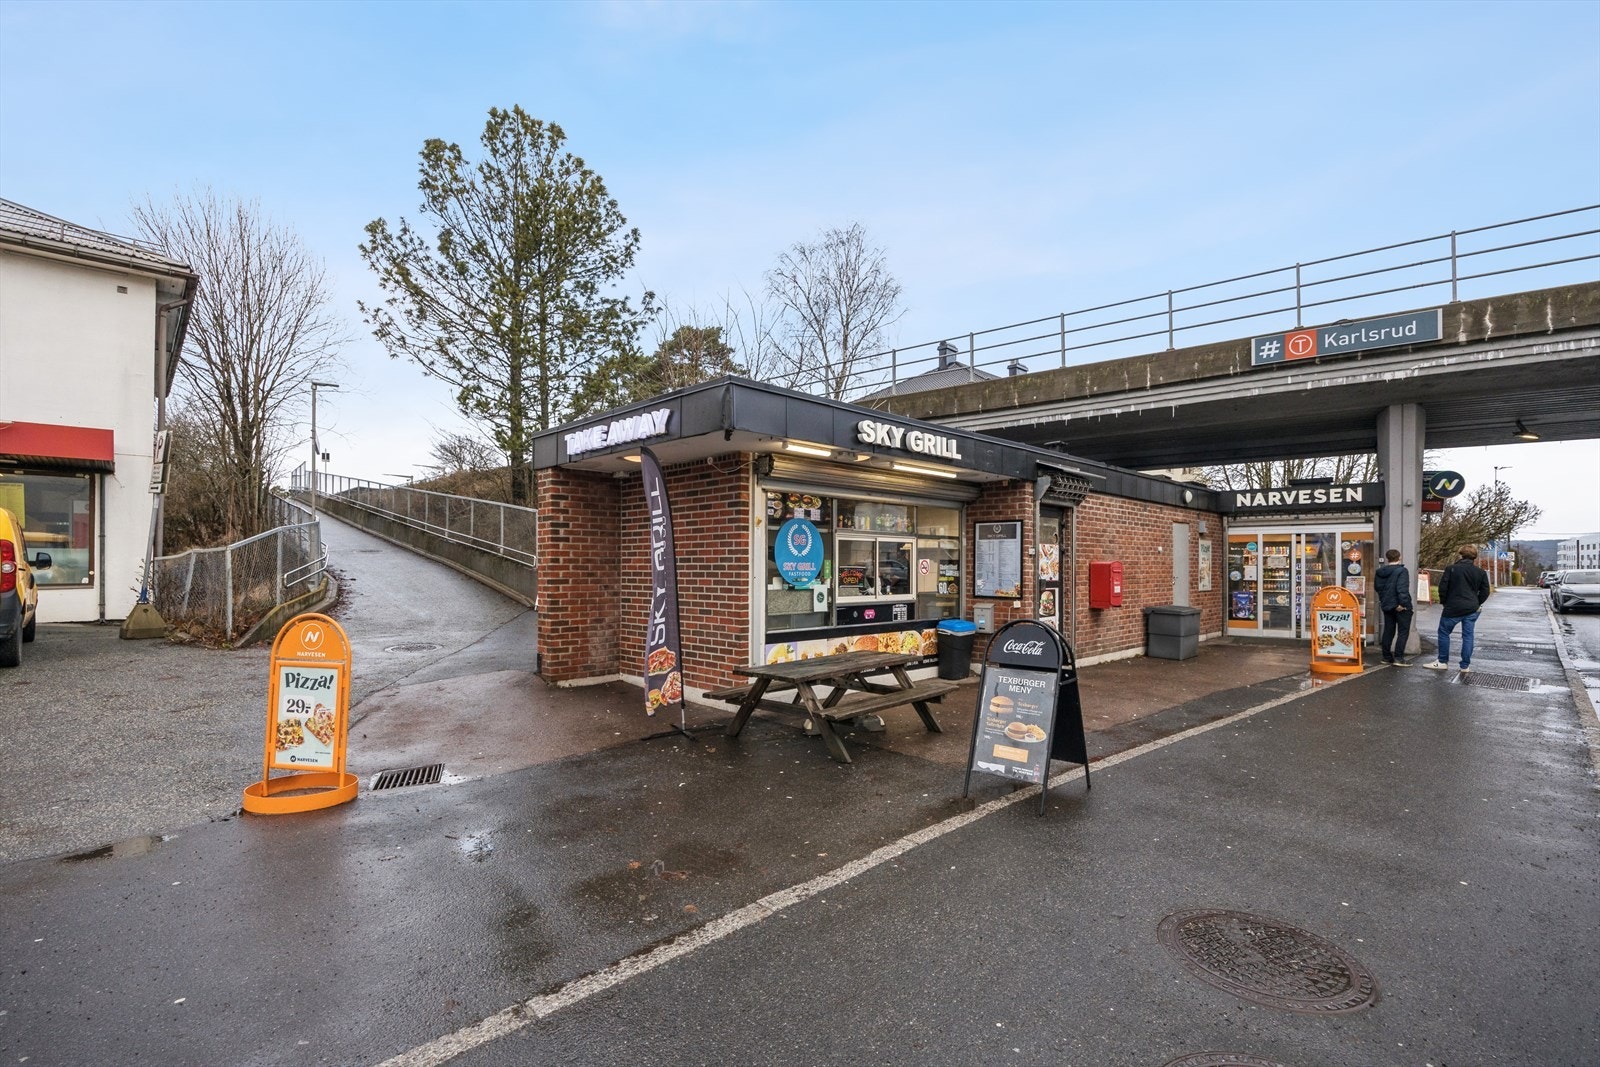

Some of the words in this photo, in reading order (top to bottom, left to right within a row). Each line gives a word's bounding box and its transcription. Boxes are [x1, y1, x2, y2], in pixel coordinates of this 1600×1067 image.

[1324, 320, 1417, 348] Karlsrud
[564, 425, 608, 455] TAKE
[606, 408, 671, 446] AWAY
[857, 420, 905, 448] SKY
[906, 430, 962, 460] GRILL
[1236, 487, 1363, 507] NARVESEN
[793, 534, 807, 546] SG
[783, 562, 797, 571] SKY
[797, 562, 816, 571] GRILL
[1319, 613, 1350, 621] Pizza!
[1003, 639, 1046, 656] Coca-Cola
[285, 672, 334, 691] Pizza!
[998, 675, 1046, 688] TEXBURGER
[1008, 685, 1033, 694] MENY
